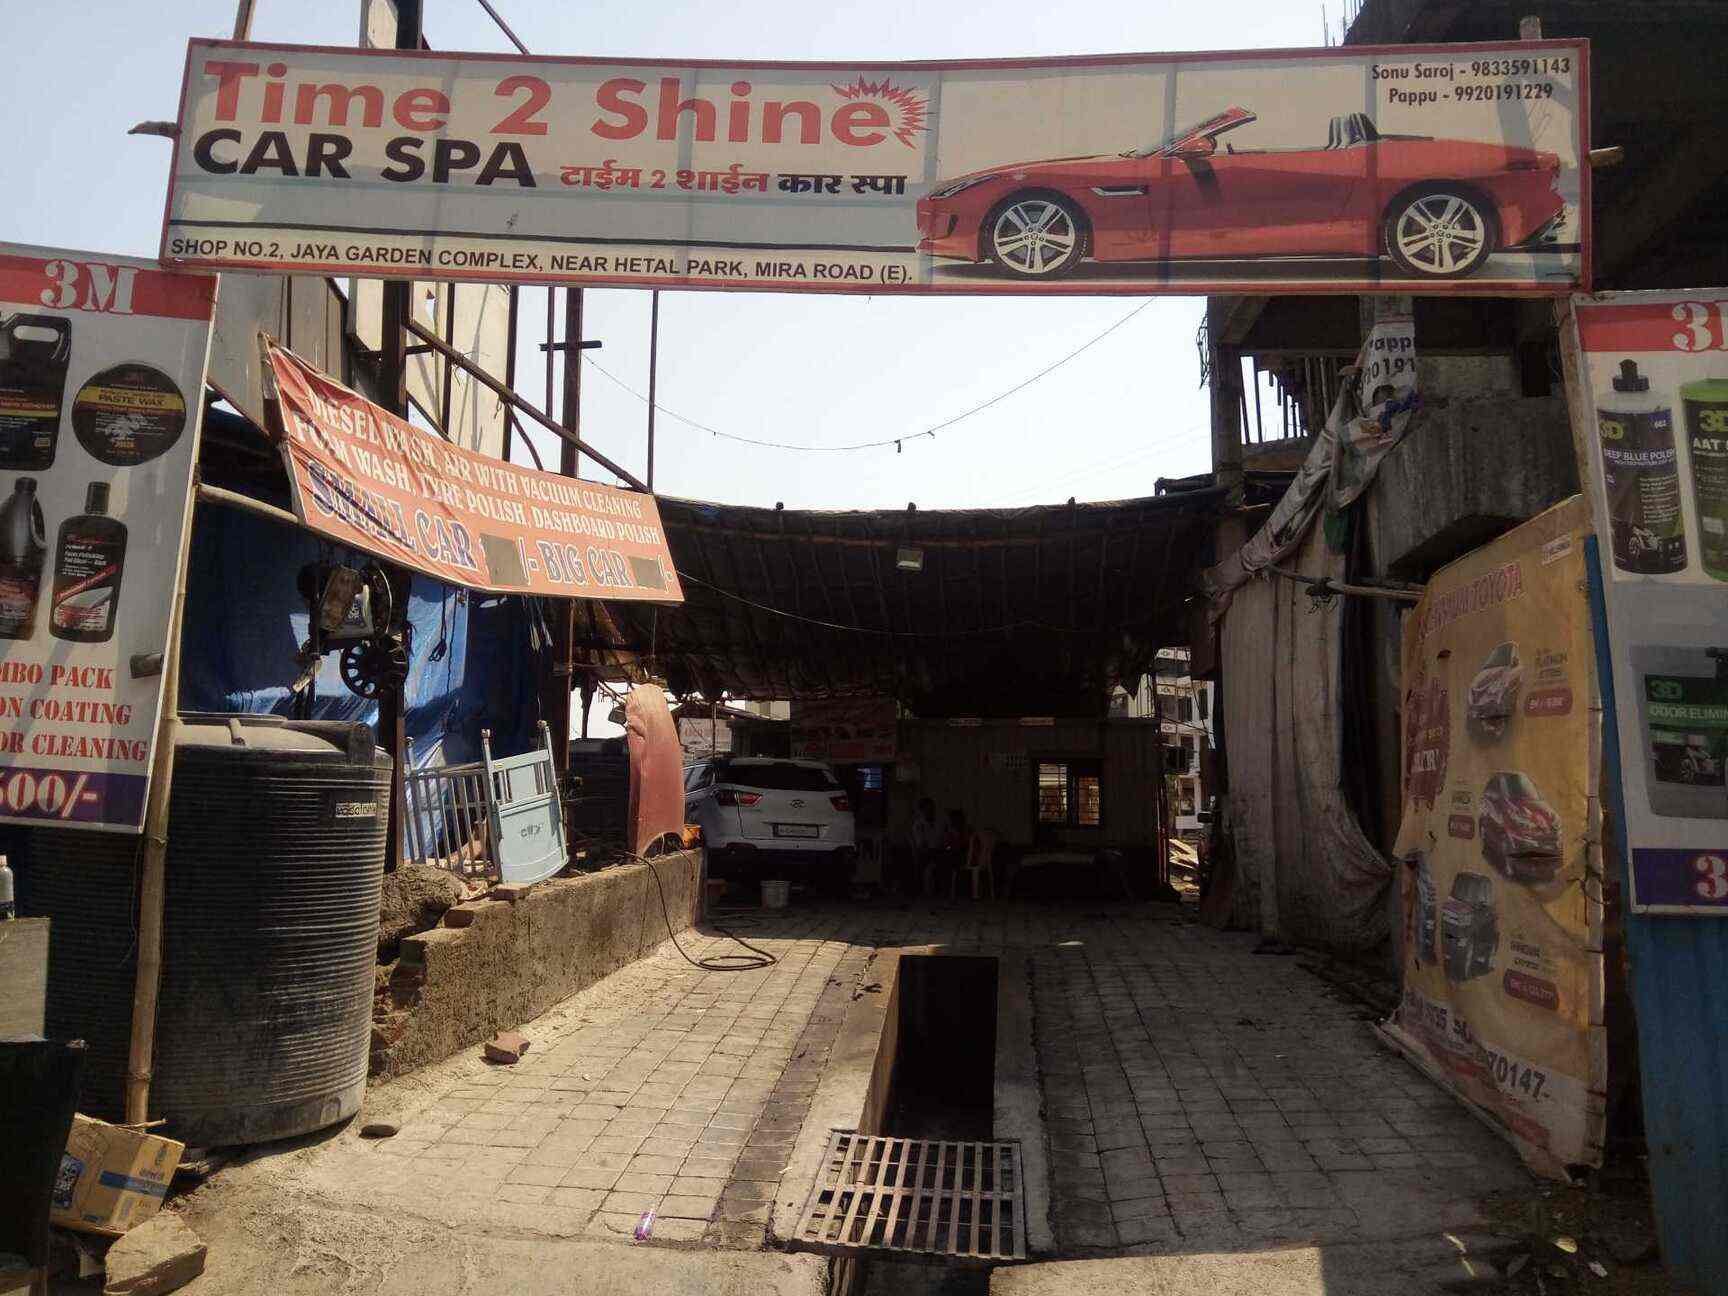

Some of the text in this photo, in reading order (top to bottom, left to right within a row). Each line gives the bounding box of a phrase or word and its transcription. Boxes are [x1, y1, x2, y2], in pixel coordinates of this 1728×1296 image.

[1372, 64, 1409, 79] Sonu
[1414, 63, 1454, 81] Saroj
[1471, 57, 1570, 77] 9833591143
[203, 61, 892, 148] Time 2 Shine
[1389, 87, 1437, 106] Pappu
[1454, 83, 1554, 101] 9920191229
[193, 128, 537, 188] CAR SPA
[559, 159, 907, 197] टाईम 2 शाईन कार स्पा
[171, 239, 913, 284] SHOP NO.2, JAYA GARDEN COMPLEX, NEAR HETAL PARK, MIRA ROAD (E).
[40, 258, 140, 315] 3M
[473, 462, 519, 496] WITH
[520, 476, 583, 508] VACUUM
[583, 490, 642, 519] CLEANING
[530, 505, 615, 542] DASHBOARD
[615, 522, 662, 545] POLISH
[415, 508, 478, 571] CAR
[536, 539, 589, 586] BIG
[587, 545, 635, 588] CAR
[51, 664, 113, 689] PACK
[30, 698, 131, 726] COATING
[32, 735, 148, 761] CLEANING
